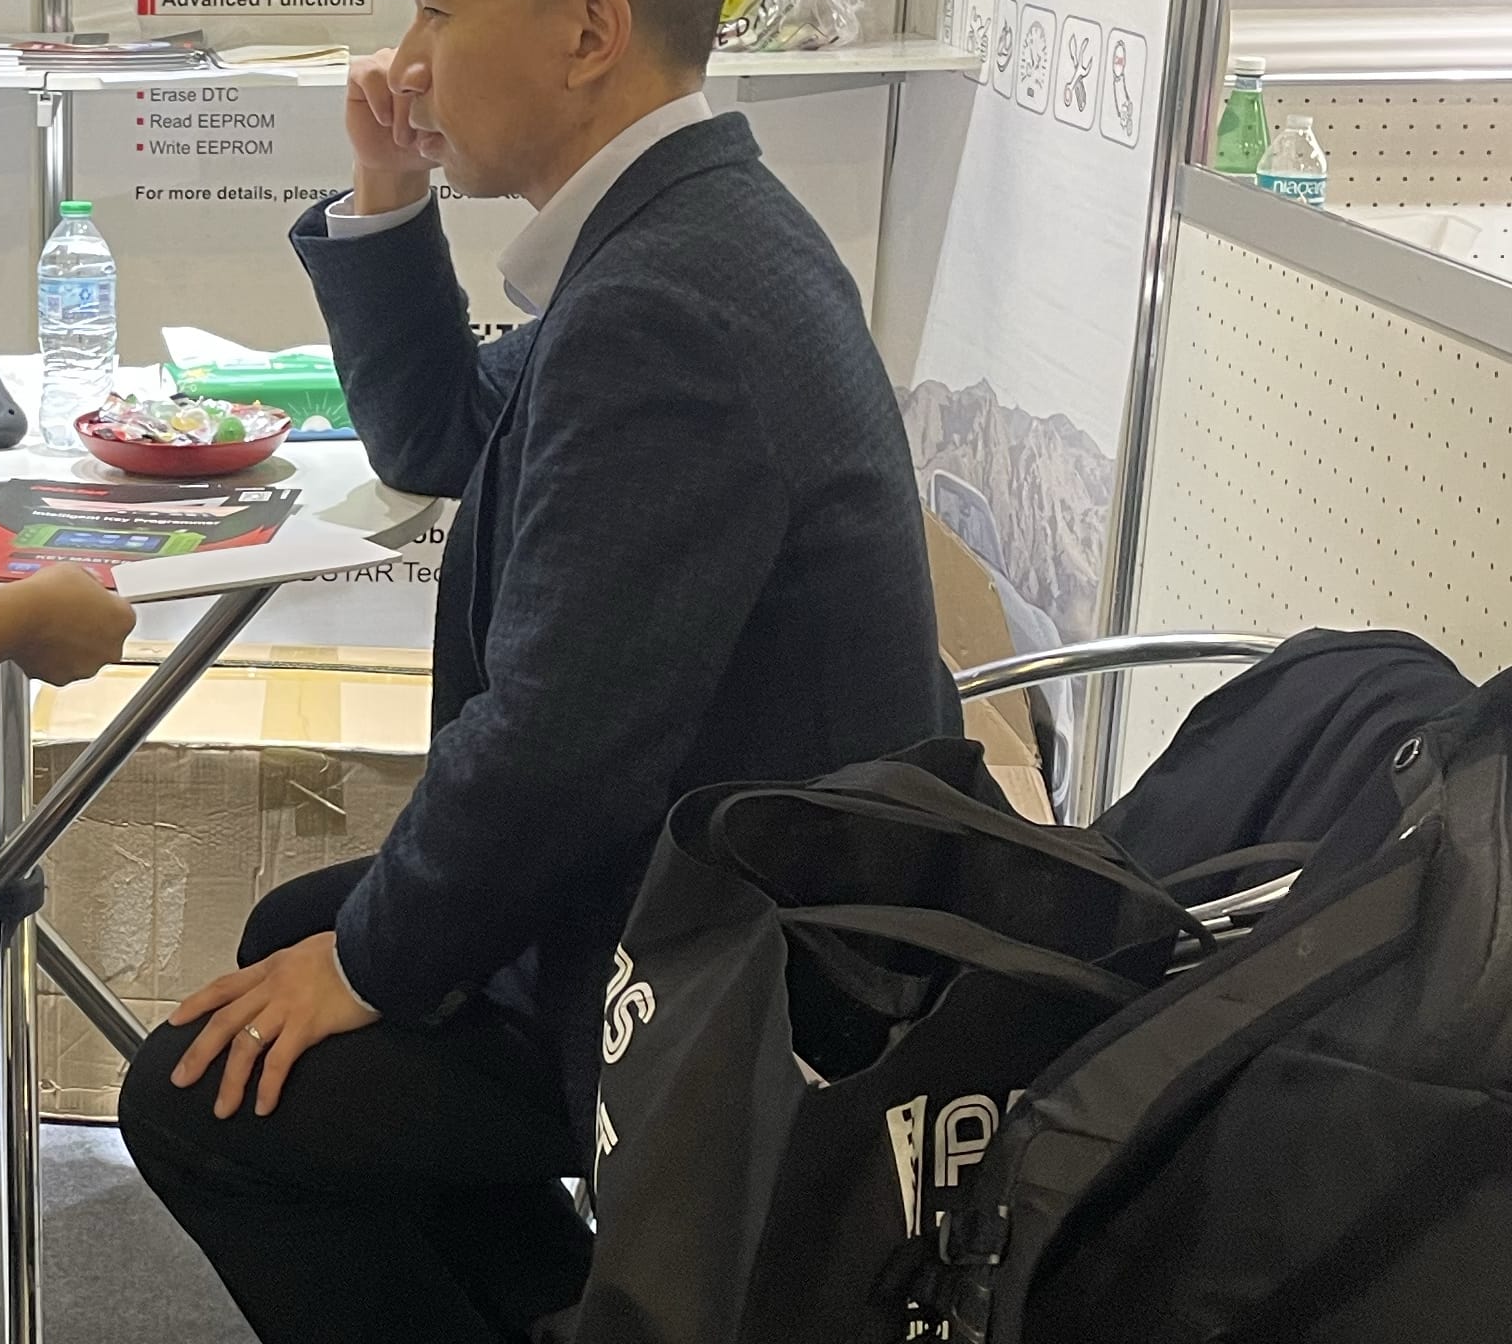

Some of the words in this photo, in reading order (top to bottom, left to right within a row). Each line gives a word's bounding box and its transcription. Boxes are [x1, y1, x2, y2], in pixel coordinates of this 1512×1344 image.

[149, 85, 197, 103] Erase
[201, 85, 240, 103] DTC
[149, 111, 193, 128] Read
[197, 111, 275, 128] EEPROM
[149, 137, 191, 154] Write
[195, 137, 273, 154] EEPROM
[135, 182, 164, 200] For
[168, 186, 212, 200] more
[216, 183, 278, 204] details,
[32, 510, 100, 522] Intelligent
[104, 515, 131, 524] Key
[134, 516, 221, 526] Programmer
[35, 554, 69, 562] KEY
